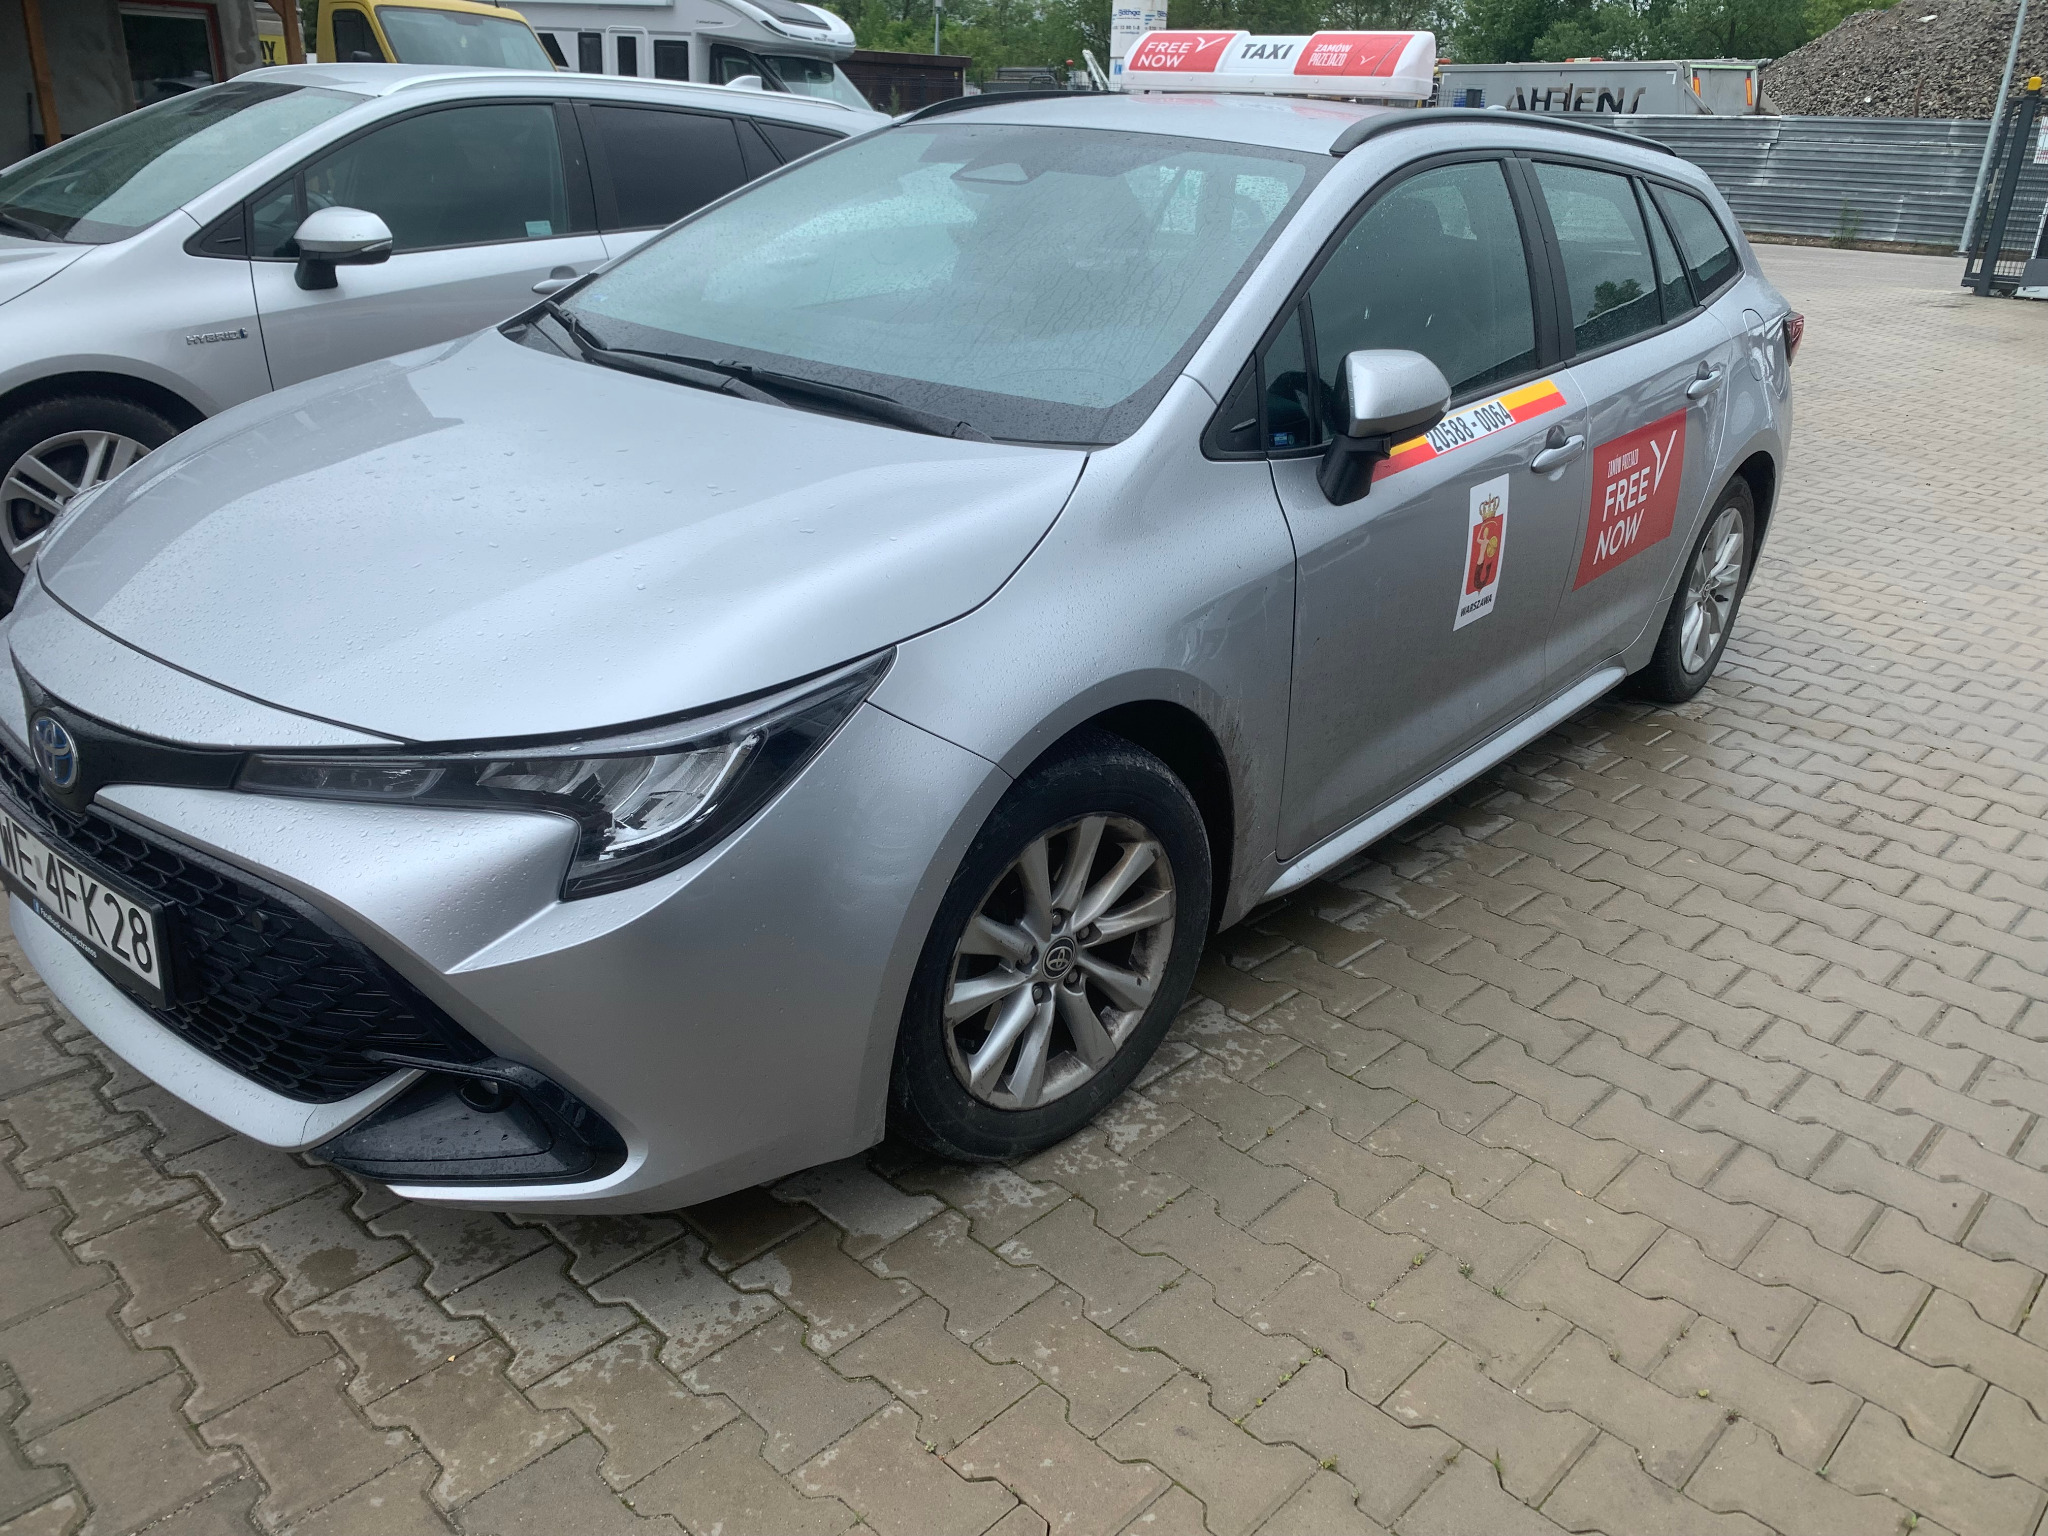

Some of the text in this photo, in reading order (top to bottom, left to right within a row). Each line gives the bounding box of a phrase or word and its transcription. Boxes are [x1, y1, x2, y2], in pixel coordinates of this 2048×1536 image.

[1144, 42, 1193, 53] FREE
[1240, 43, 1294, 59] TAXI
[1314, 42, 1353, 52] ZAMÓW
[1137, 54, 1185, 67] NOW
[1307, 53, 1347, 66] PRZEJAZD
[186, 330, 238, 345] HYBRID
[1602, 466, 1651, 522] FREE
[1593, 508, 1644, 565] NOW
[1460, 594, 1492, 617] WARSZAWA
[46, 852, 152, 974] 4FK28
